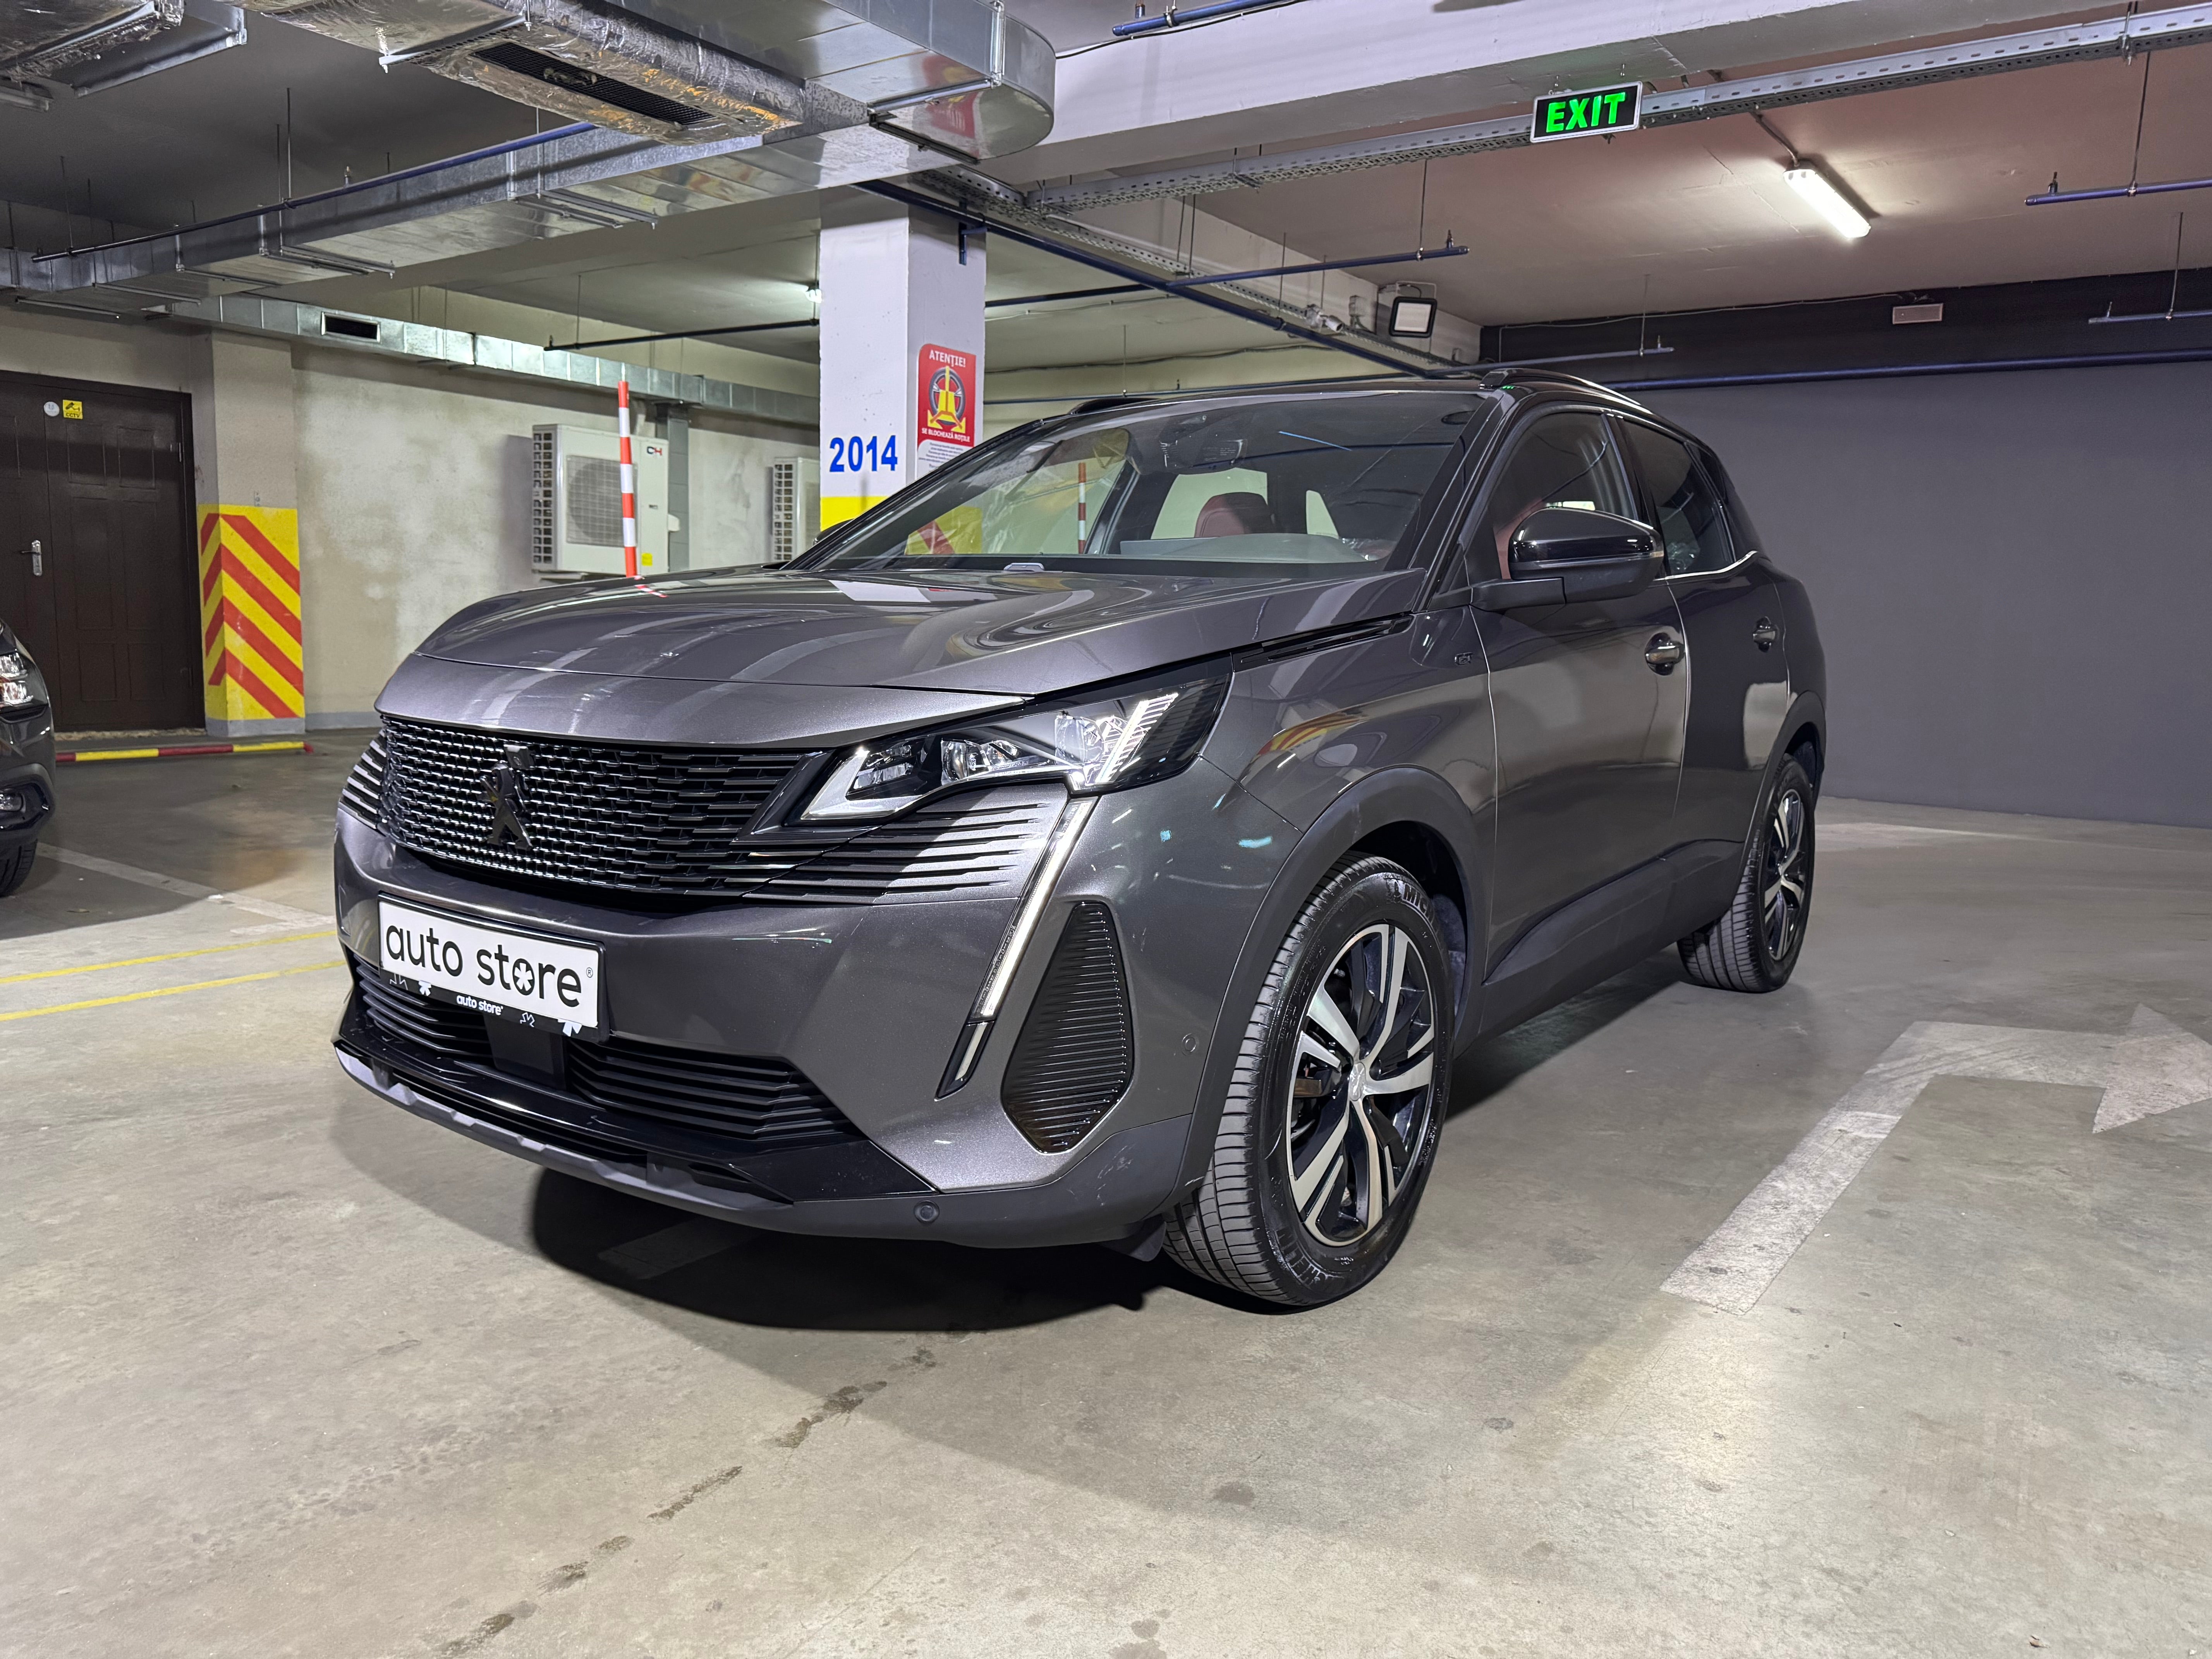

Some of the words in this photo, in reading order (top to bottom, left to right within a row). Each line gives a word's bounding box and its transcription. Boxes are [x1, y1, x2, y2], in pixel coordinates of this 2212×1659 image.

[1546, 92, 1625, 132] EXIT
[646, 446, 663, 456] CH
[829, 435, 898, 472] 2014
[386, 925, 463, 977] auto
[457, 995, 477, 1008] auto
